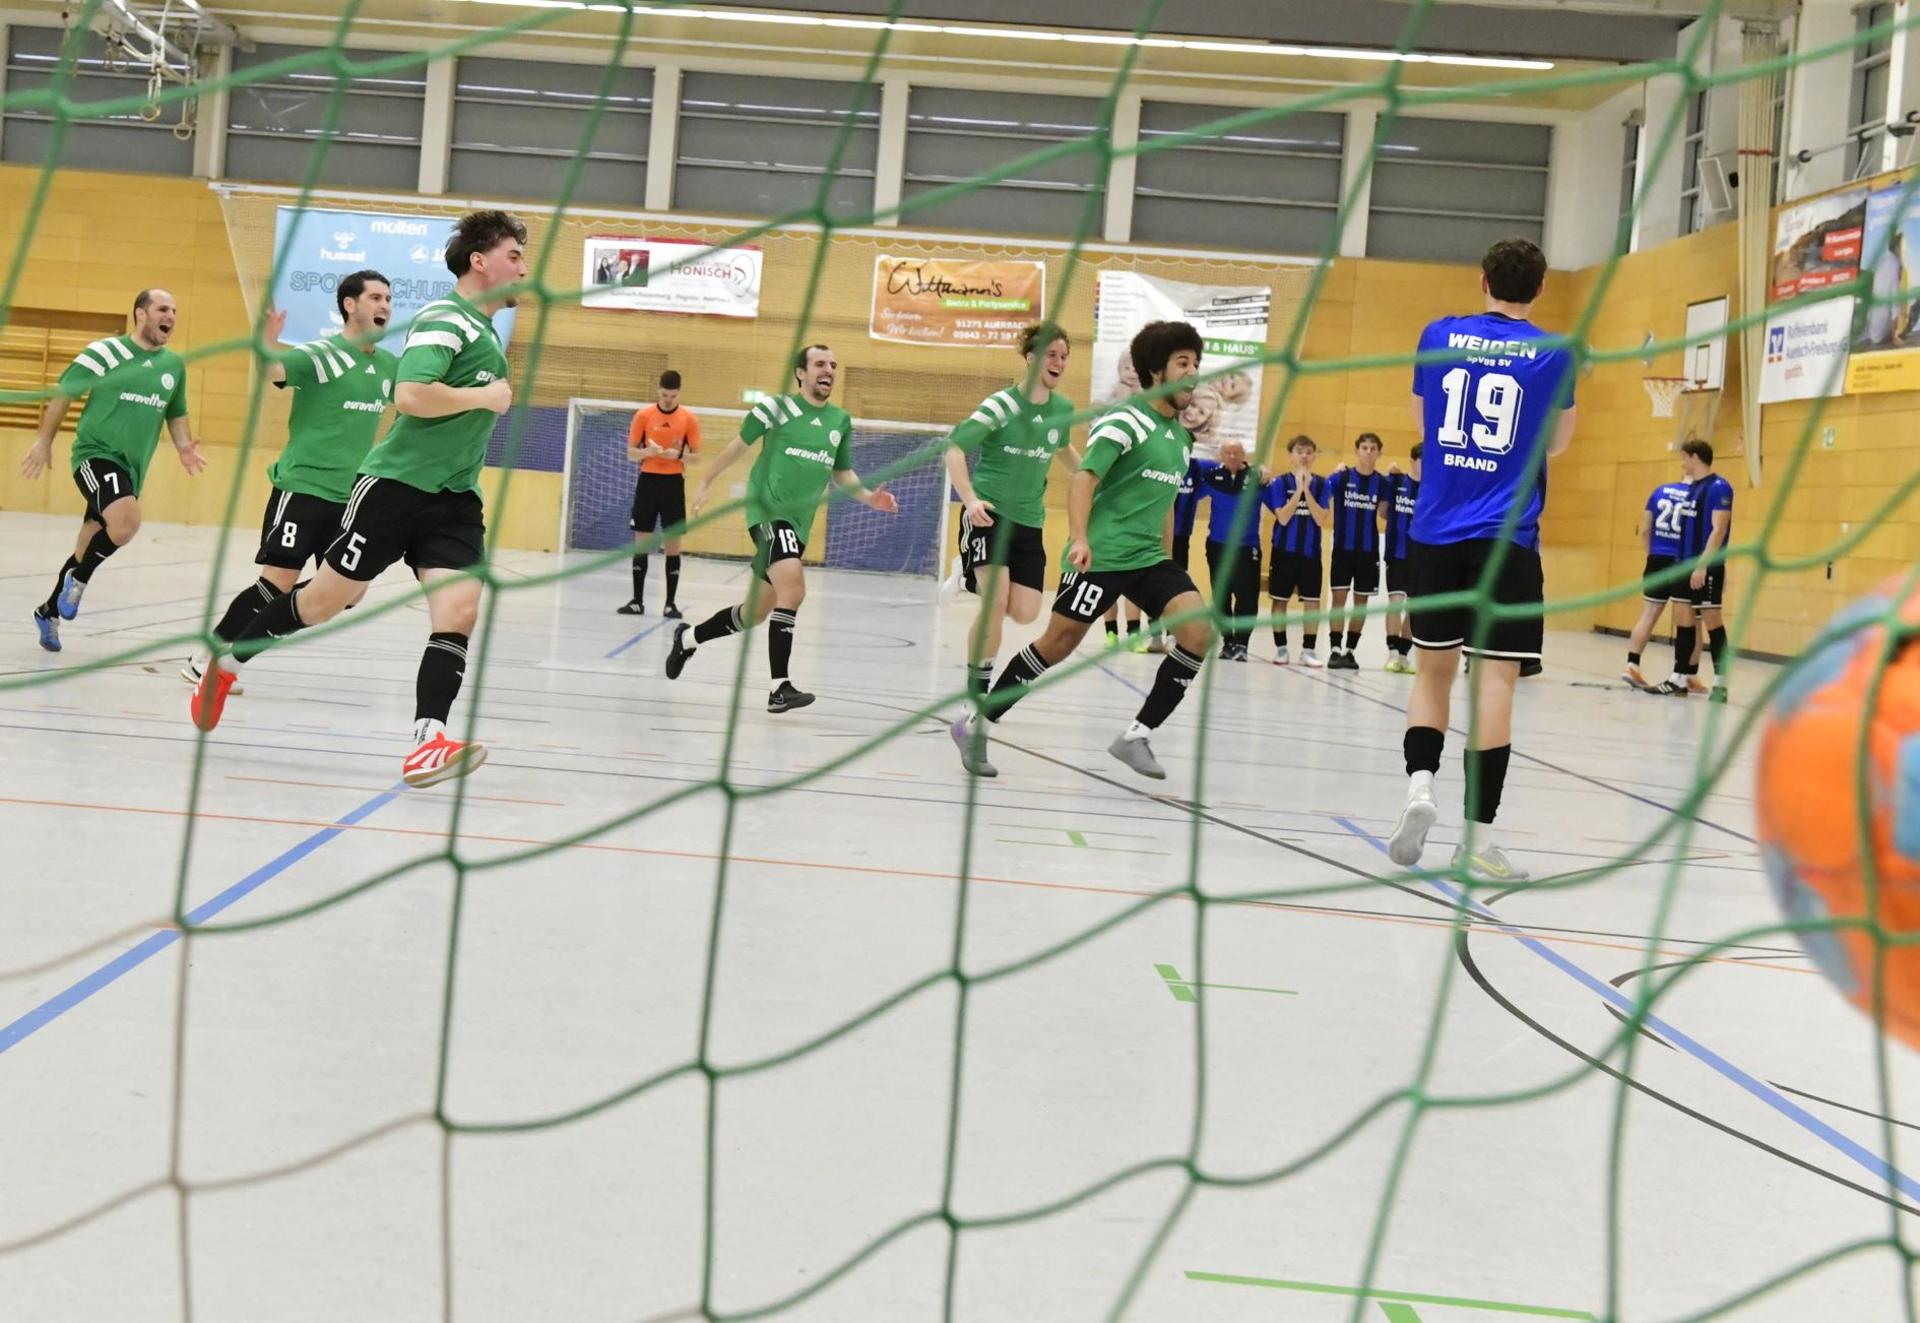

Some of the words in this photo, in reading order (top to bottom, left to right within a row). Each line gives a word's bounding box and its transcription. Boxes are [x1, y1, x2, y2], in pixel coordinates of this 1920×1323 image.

[371, 220, 428, 236] molten
[320, 248, 366, 262] hummel
[670, 261, 732, 280] HONISCH
[1448, 333, 1537, 359] WEIDEN
[1498, 358, 1512, 367] SV
[1437, 367, 1524, 455] 19
[1444, 453, 1498, 472] BRAND
[104, 472, 120, 494] 7
[1344, 490, 1370, 502] Urban
[1395, 496, 1415, 506] Urba
[281, 521, 297, 548] 8
[777, 528, 799, 553] 18
[340, 532, 367, 572] 5
[972, 536, 987, 561] 31
[1070, 580, 1104, 617] 19
